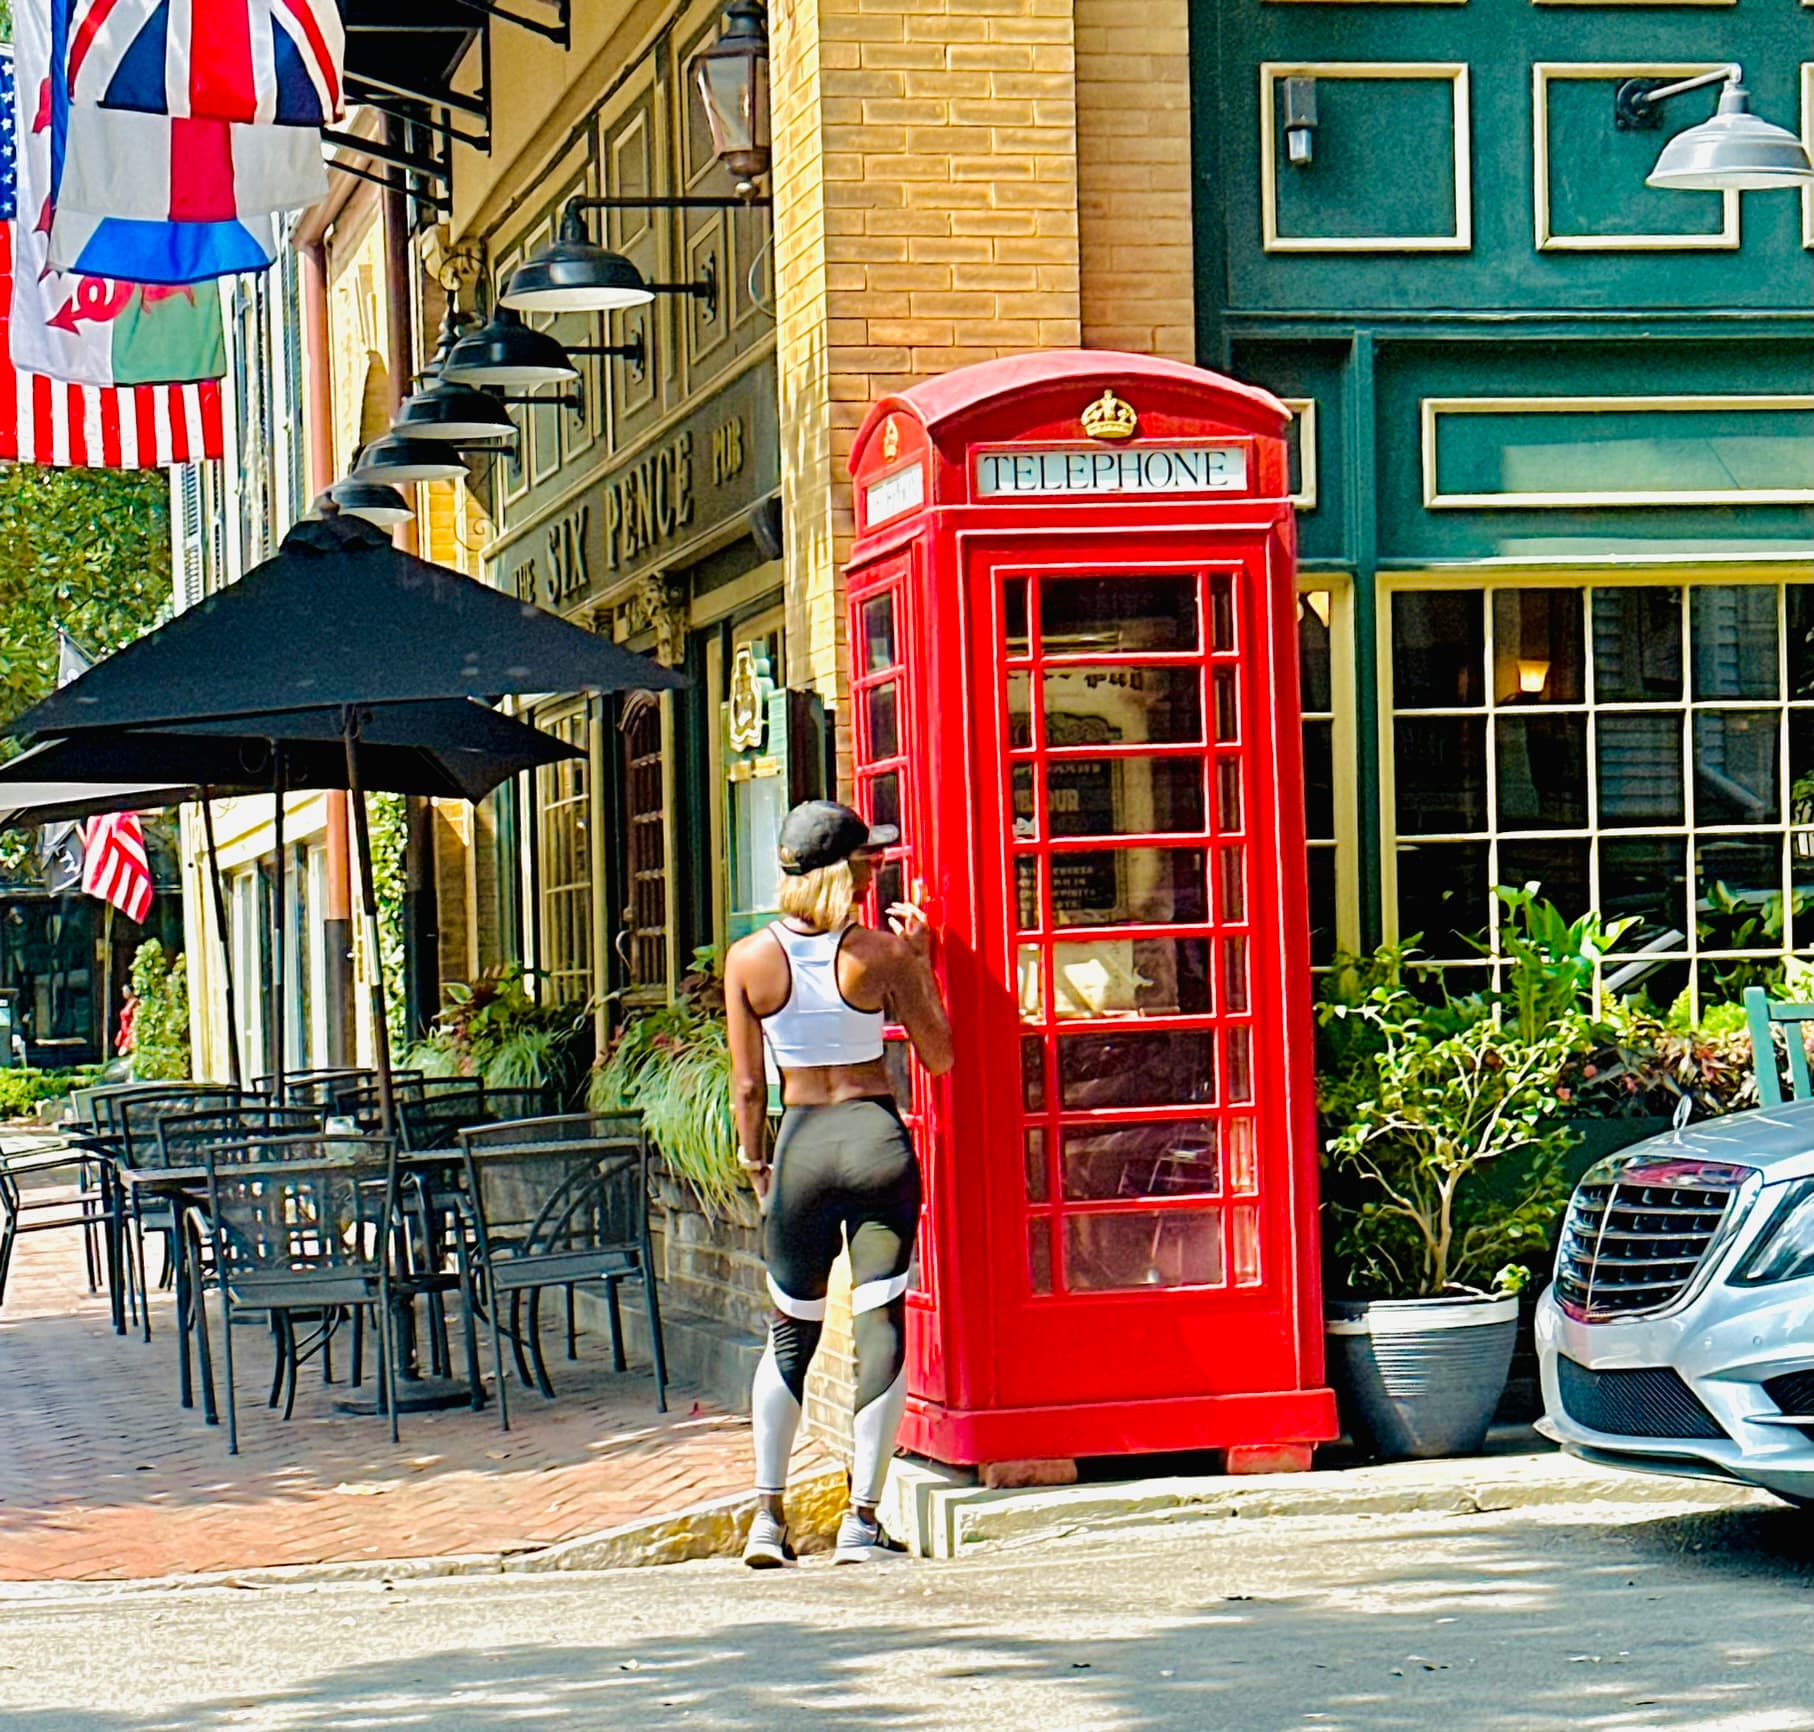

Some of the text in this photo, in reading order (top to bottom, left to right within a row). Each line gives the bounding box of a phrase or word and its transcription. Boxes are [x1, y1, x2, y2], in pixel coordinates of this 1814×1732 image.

[513, 415, 743, 606] THE SIX PENCE PUB
[983, 451, 1229, 492] TELEPHONE
